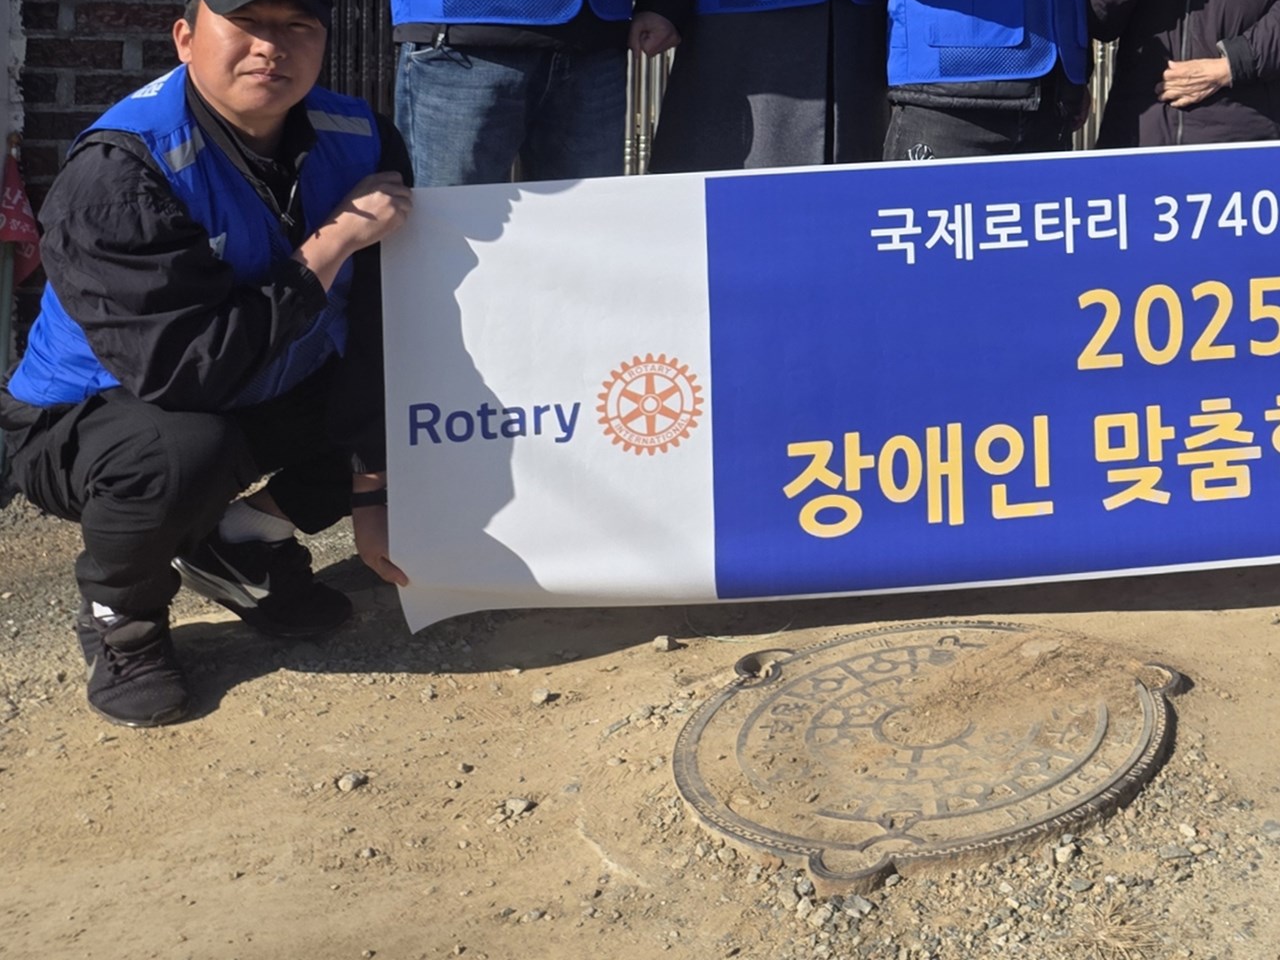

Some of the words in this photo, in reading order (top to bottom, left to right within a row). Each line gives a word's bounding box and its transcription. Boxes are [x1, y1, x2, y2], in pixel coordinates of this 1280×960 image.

[870, 193, 1129, 265] 국제로타리
[628, 365, 672, 378] ROTARY
[408, 401, 581, 446] Rotary
[614, 417, 688, 446] INTERNATIONAL
[782, 414, 1054, 539] 장애인
